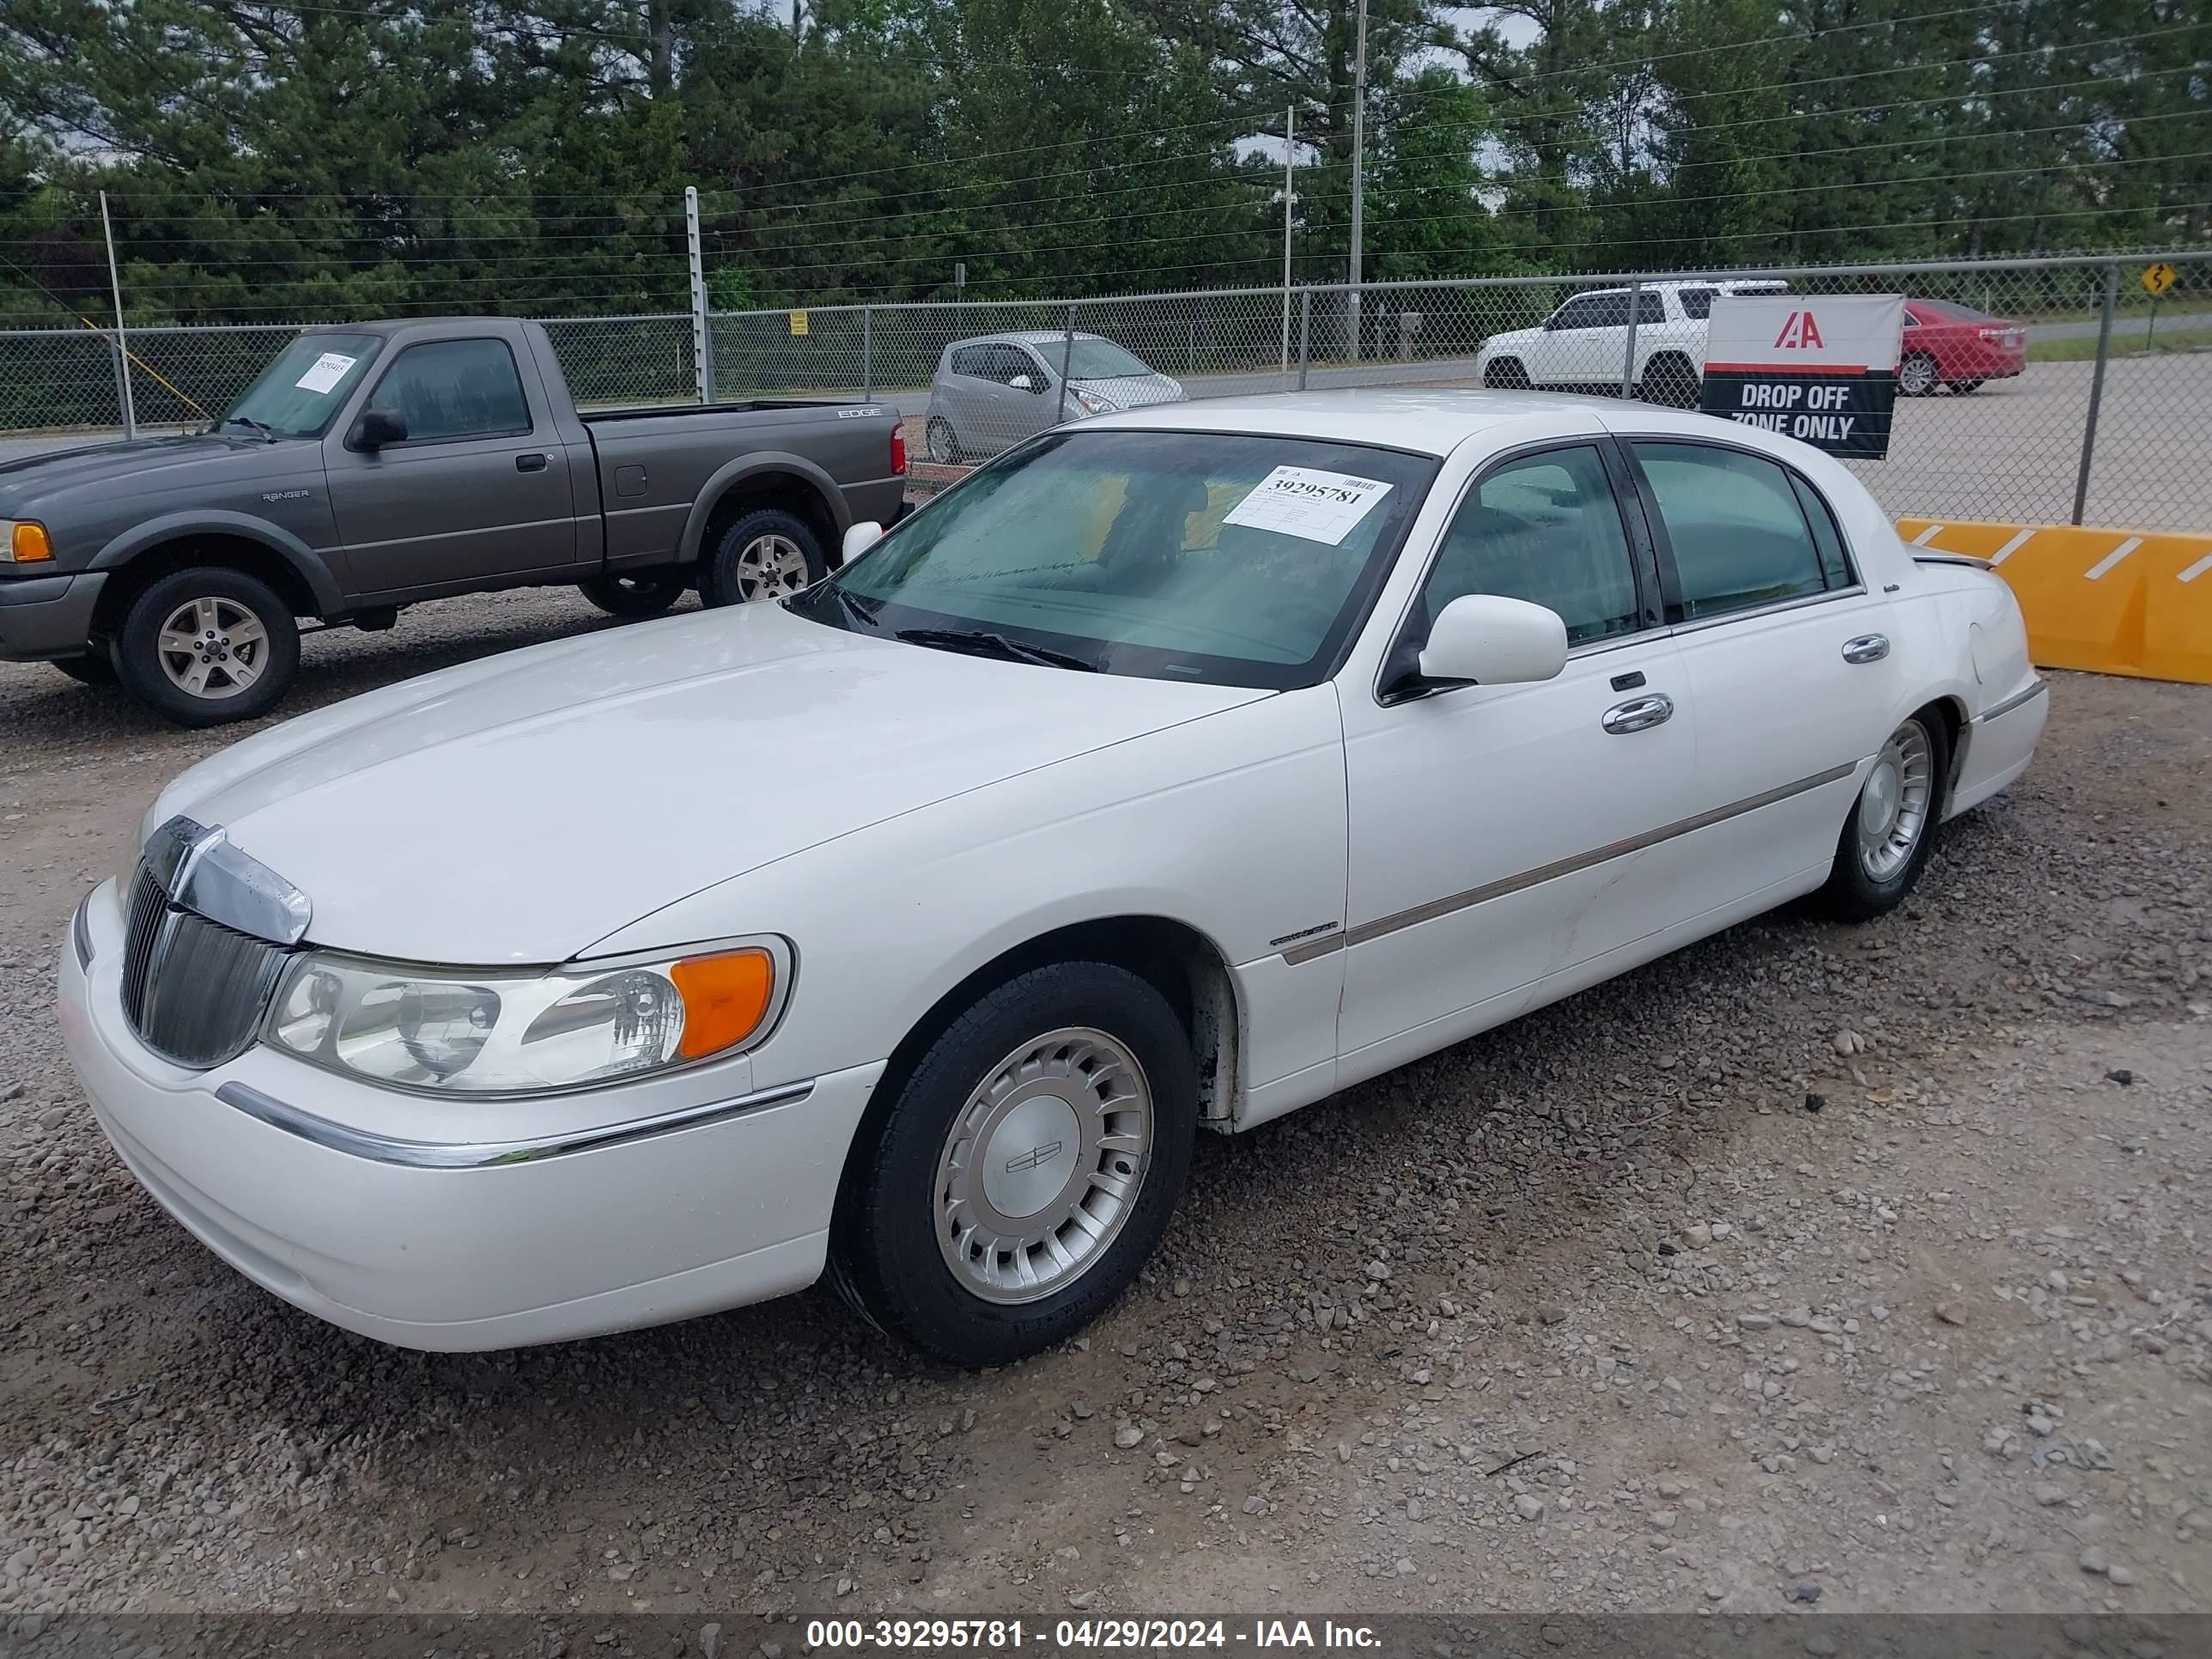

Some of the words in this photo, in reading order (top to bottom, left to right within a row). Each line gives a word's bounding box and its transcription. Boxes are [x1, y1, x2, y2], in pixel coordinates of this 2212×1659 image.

[1741, 383, 1802, 409] DROP
[1807, 386, 1850, 410] OFF
[837, 408, 883, 418] EDGE
[1794, 416, 1855, 440] ONLY
[1267, 479, 1363, 505] 39295781
